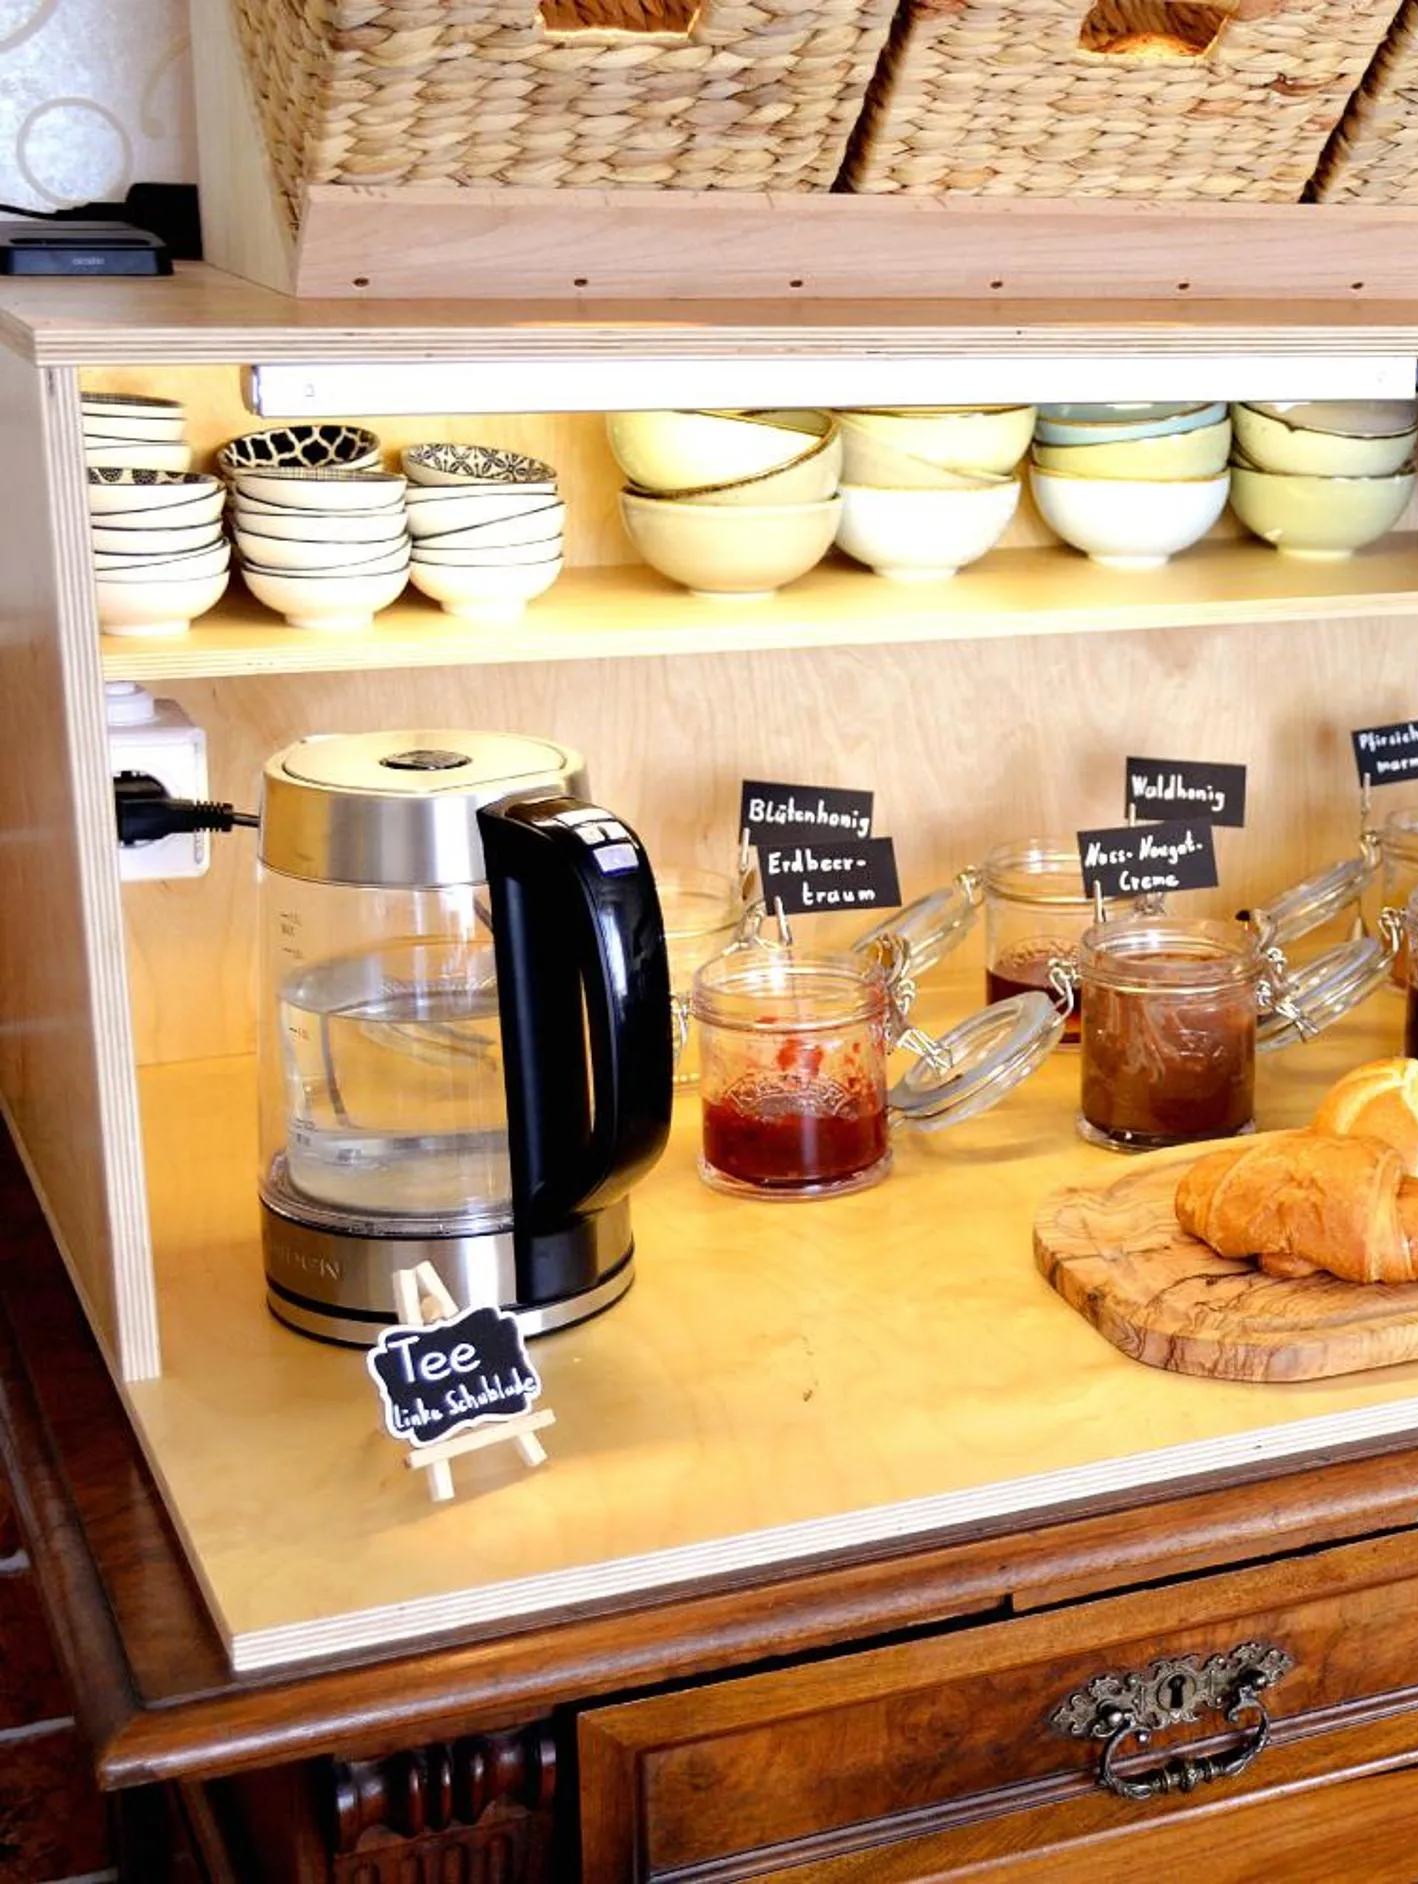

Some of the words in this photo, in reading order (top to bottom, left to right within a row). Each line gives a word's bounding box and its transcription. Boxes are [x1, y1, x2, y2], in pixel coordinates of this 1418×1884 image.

[1131, 773, 1226, 812] Waldhonig
[748, 796, 870, 838] Blütenhonig
[768, 847, 867, 875] Erdbeer-
[1118, 870, 1180, 891] Creme
[802, 881, 876, 906] traum
[387, 1335, 481, 1383] Tee
[444, 1366, 537, 1416] Schublade
